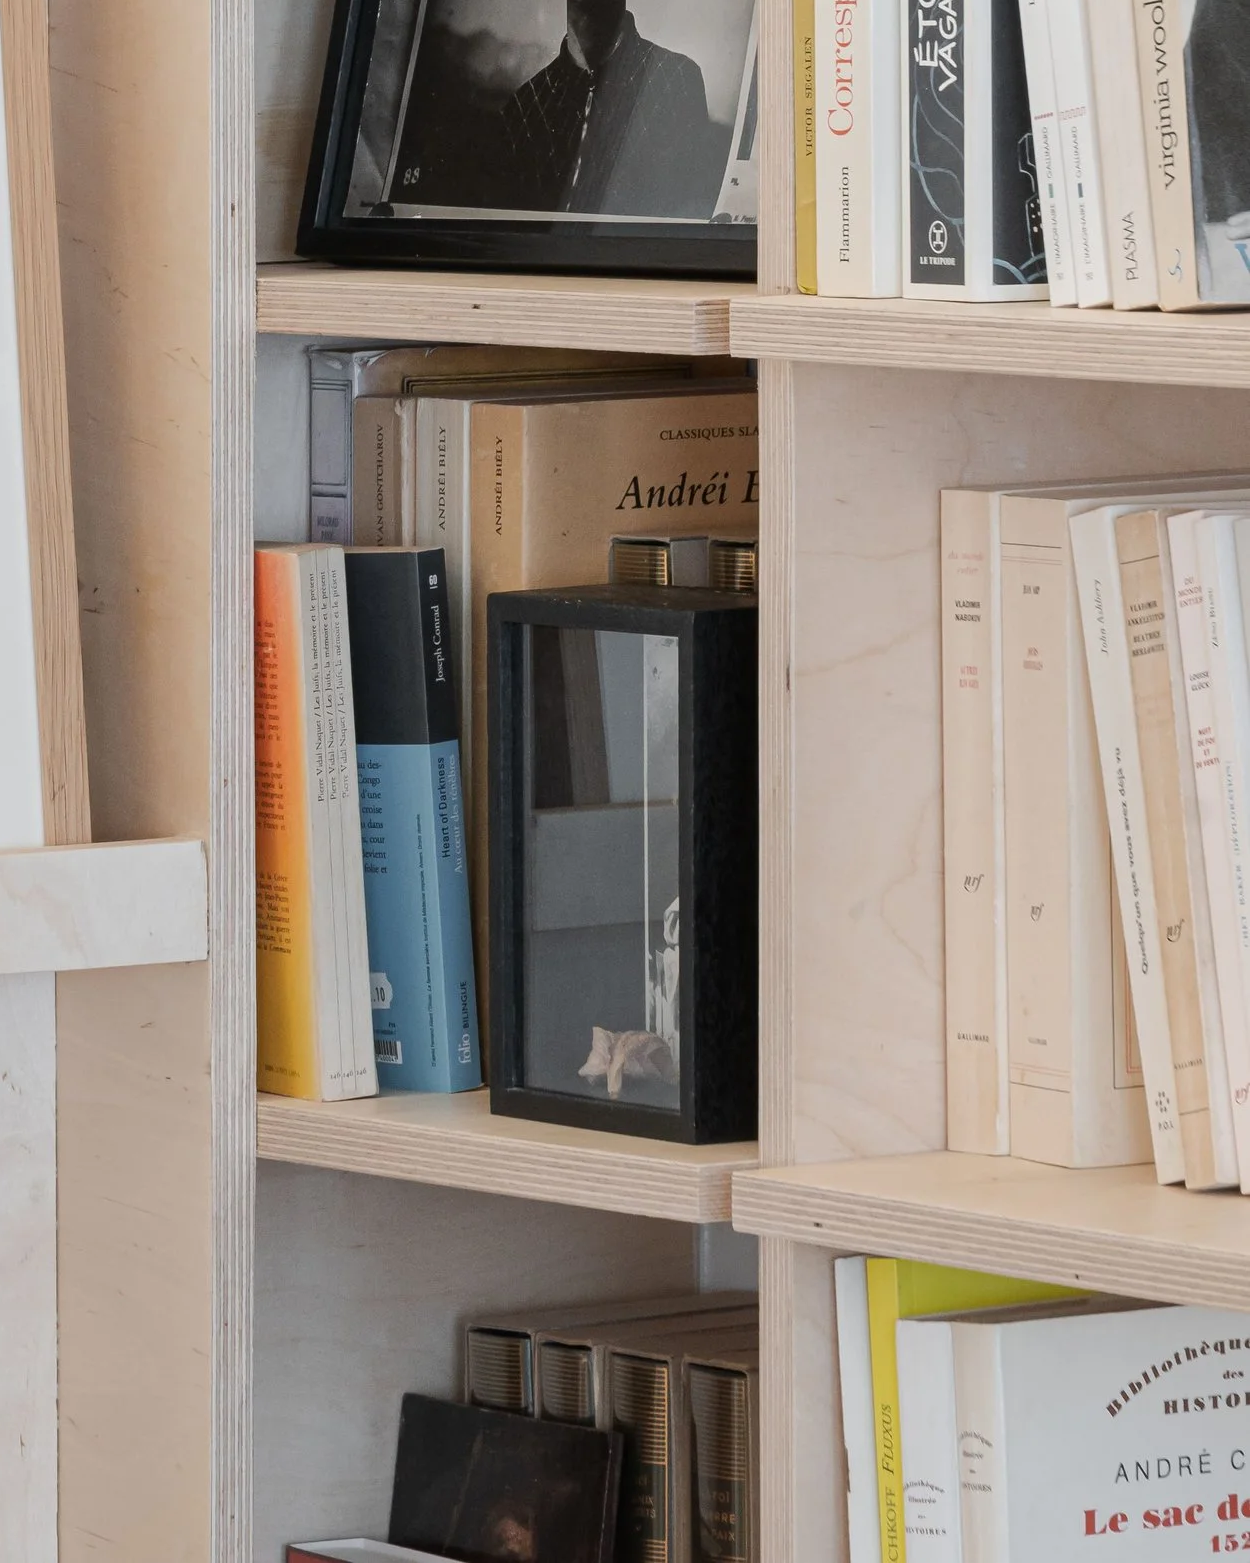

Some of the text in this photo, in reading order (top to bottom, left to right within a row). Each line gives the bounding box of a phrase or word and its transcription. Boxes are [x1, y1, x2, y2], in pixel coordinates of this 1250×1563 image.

[804, 36, 813, 157] VICTOR SEGALEN
[1156, 78, 1177, 190] virginia
[839, 166, 850, 264] Flammarion
[1126, 210, 1139, 281] PLASMA
[920, 256, 956, 266] LE TRIPODE
[376, 424, 384, 511] GONTCHAROV
[660, 426, 734, 441] CLASSIQUES
[438, 426, 446, 530] ANDRÉI BIÉLY
[494, 436, 503, 536] ANDRÉI BIÉLY
[616, 470, 729, 510] Andréi
[310, 572, 318, 600] présent
[954, 600, 980, 608] VLADIMIR
[430, 604, 446, 682] Joseph Conrad
[361, 788, 382, 799] d'une
[367, 759, 382, 770] des-
[368, 819, 384, 829] dans
[438, 757, 450, 858] Heart of Darkness
[448, 753, 462, 874] Au cœur des ténèbres
[1114, 746, 1148, 975] Quelqu'un que vous avez déjà vu
[458, 981, 471, 1064] folio BILINGUE
[958, 1032, 990, 1043] GALLIMARD
[1222, 1370, 1244, 1380] des
[882, 1404, 894, 1476] FLUXUS
[1114, 1448, 1246, 1484] ANDRÉ C
[1083, 1508, 1129, 1536] Le
[1142, 1502, 1204, 1530] sac
